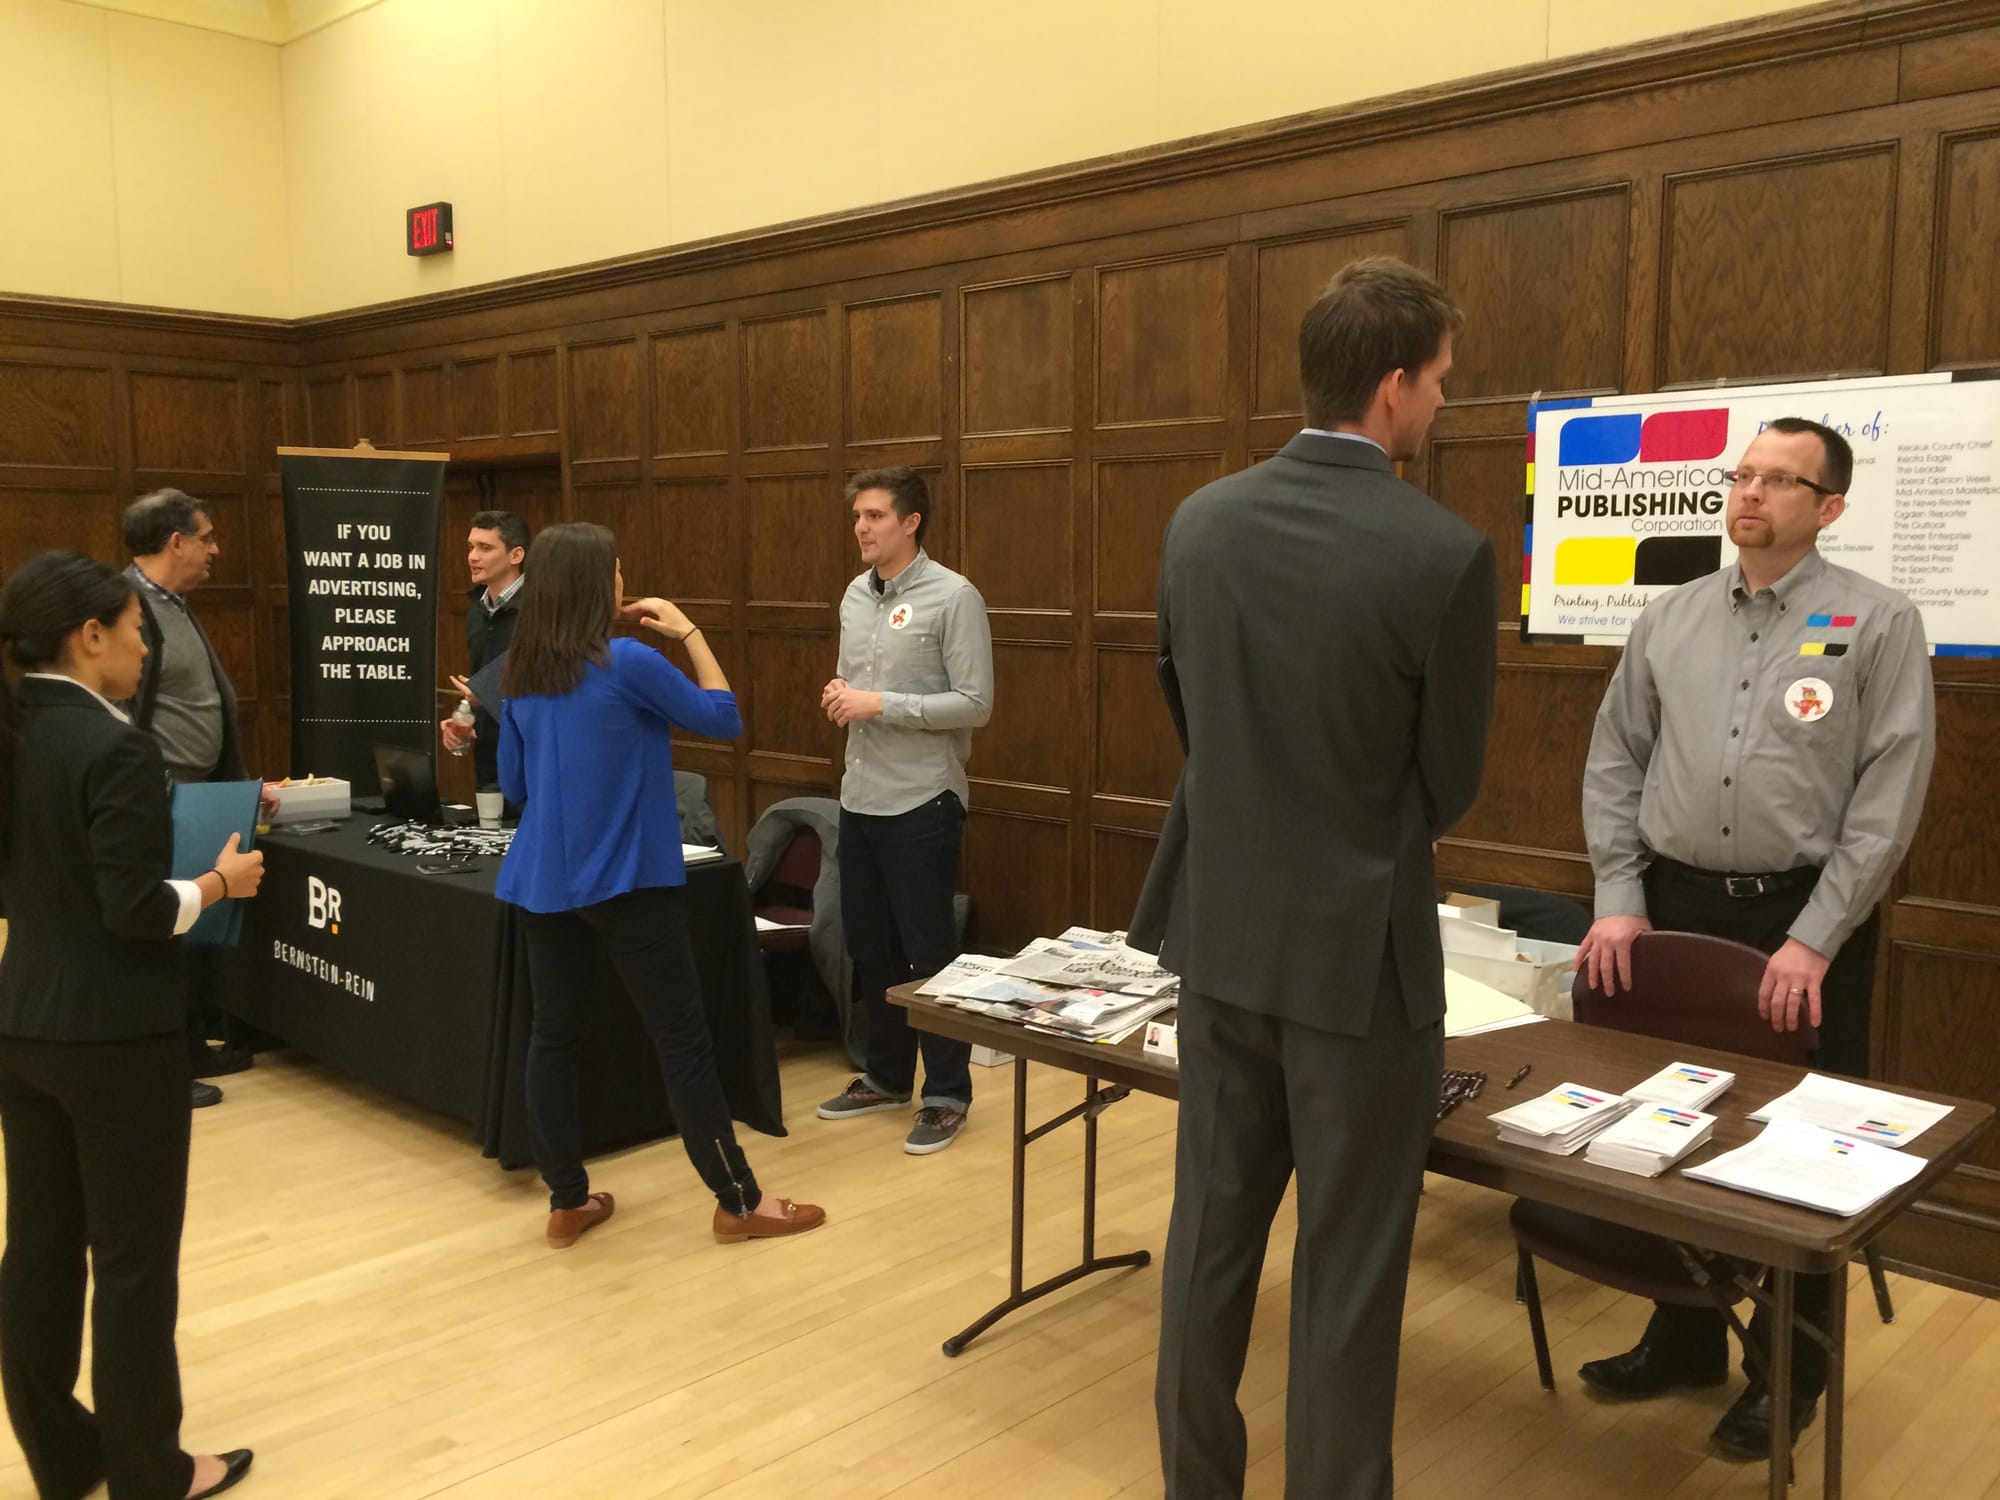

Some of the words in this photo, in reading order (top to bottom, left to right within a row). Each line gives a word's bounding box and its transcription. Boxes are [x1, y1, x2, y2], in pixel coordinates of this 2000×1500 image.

[413, 208, 438, 249] EXIT
[1931, 441, 1965, 451] County
[1914, 465, 1946, 473] Leader
[1559, 465, 1724, 491] Mid-America
[1557, 491, 1723, 518] PUBLISHING
[337, 524, 352, 539] IF
[357, 524, 391, 540] YOU
[1631, 517, 1722, 533] Corporation
[1911, 520, 1946, 529] Outlook
[1929, 543, 1959, 551] Herald
[304, 551, 352, 567] WANT
[357, 552, 369, 568] A
[374, 553, 403, 569] JOB
[408, 554, 425, 569] IN
[1909, 564, 1952, 573] Spectrum
[308, 579, 422, 599] ADVERTISING,
[1919, 588, 1952, 597] County
[1954, 587, 1989, 596] Monitor
[1606, 593, 1649, 607] Publish
[335, 608, 396, 624] PLEASE
[1558, 615, 1576, 625] We
[1578, 614, 1607, 625] strive
[1610, 615, 1626, 625] for
[321, 635, 410, 652] APPROACH
[320, 663, 351, 678] THE
[356, 664, 412, 680] TABLE.
[274, 939, 374, 1001] BERNSTEIN-REIN
